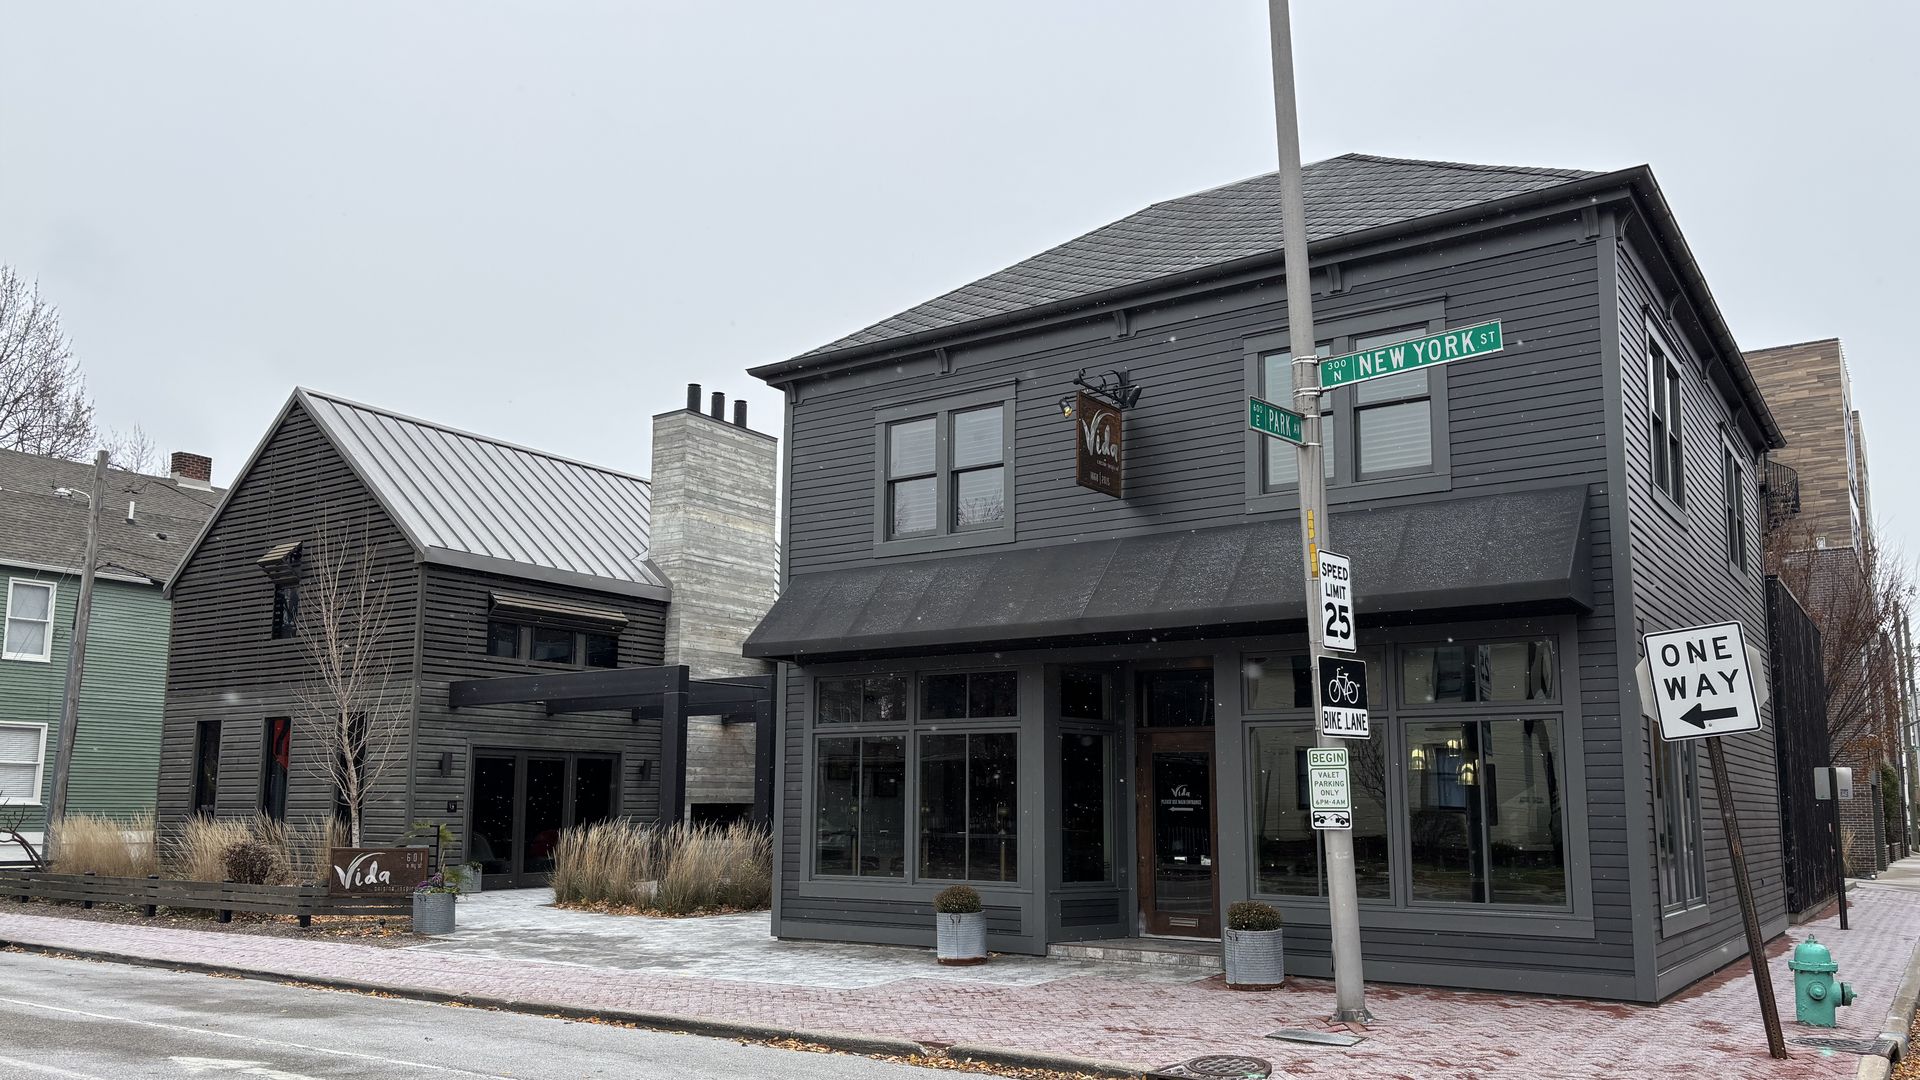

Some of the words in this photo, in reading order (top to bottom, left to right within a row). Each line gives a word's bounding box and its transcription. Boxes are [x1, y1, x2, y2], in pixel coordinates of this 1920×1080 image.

[1358, 346, 1405, 376] NEW
[1412, 331, 1476, 364] YORK
[1480, 331, 1495, 345] ST
[1328, 359, 1347, 370] 300
[1333, 370, 1342, 382] N
[1253, 403, 1263, 413] 600
[1256, 414, 1260, 426] E
[1269, 408, 1291, 437] PARK
[1082, 409, 1118, 462] Vida
[1321, 562, 1348, 581] SPEED
[1325, 582, 1346, 600] LIMIT
[1324, 602, 1351, 640] 25
[1661, 635, 1733, 667] ONE
[1663, 668, 1739, 701] WAY
[1323, 710, 1342, 730] BIKE
[1346, 711, 1368, 731] LANE
[1312, 753, 1344, 763] BEGIN
[1314, 780, 1345, 788] PARKING
[1318, 771, 1340, 779] VALET
[1171, 784, 1190, 798] Vida
[406, 852, 423, 862] 601
[334, 852, 391, 890] Vida
